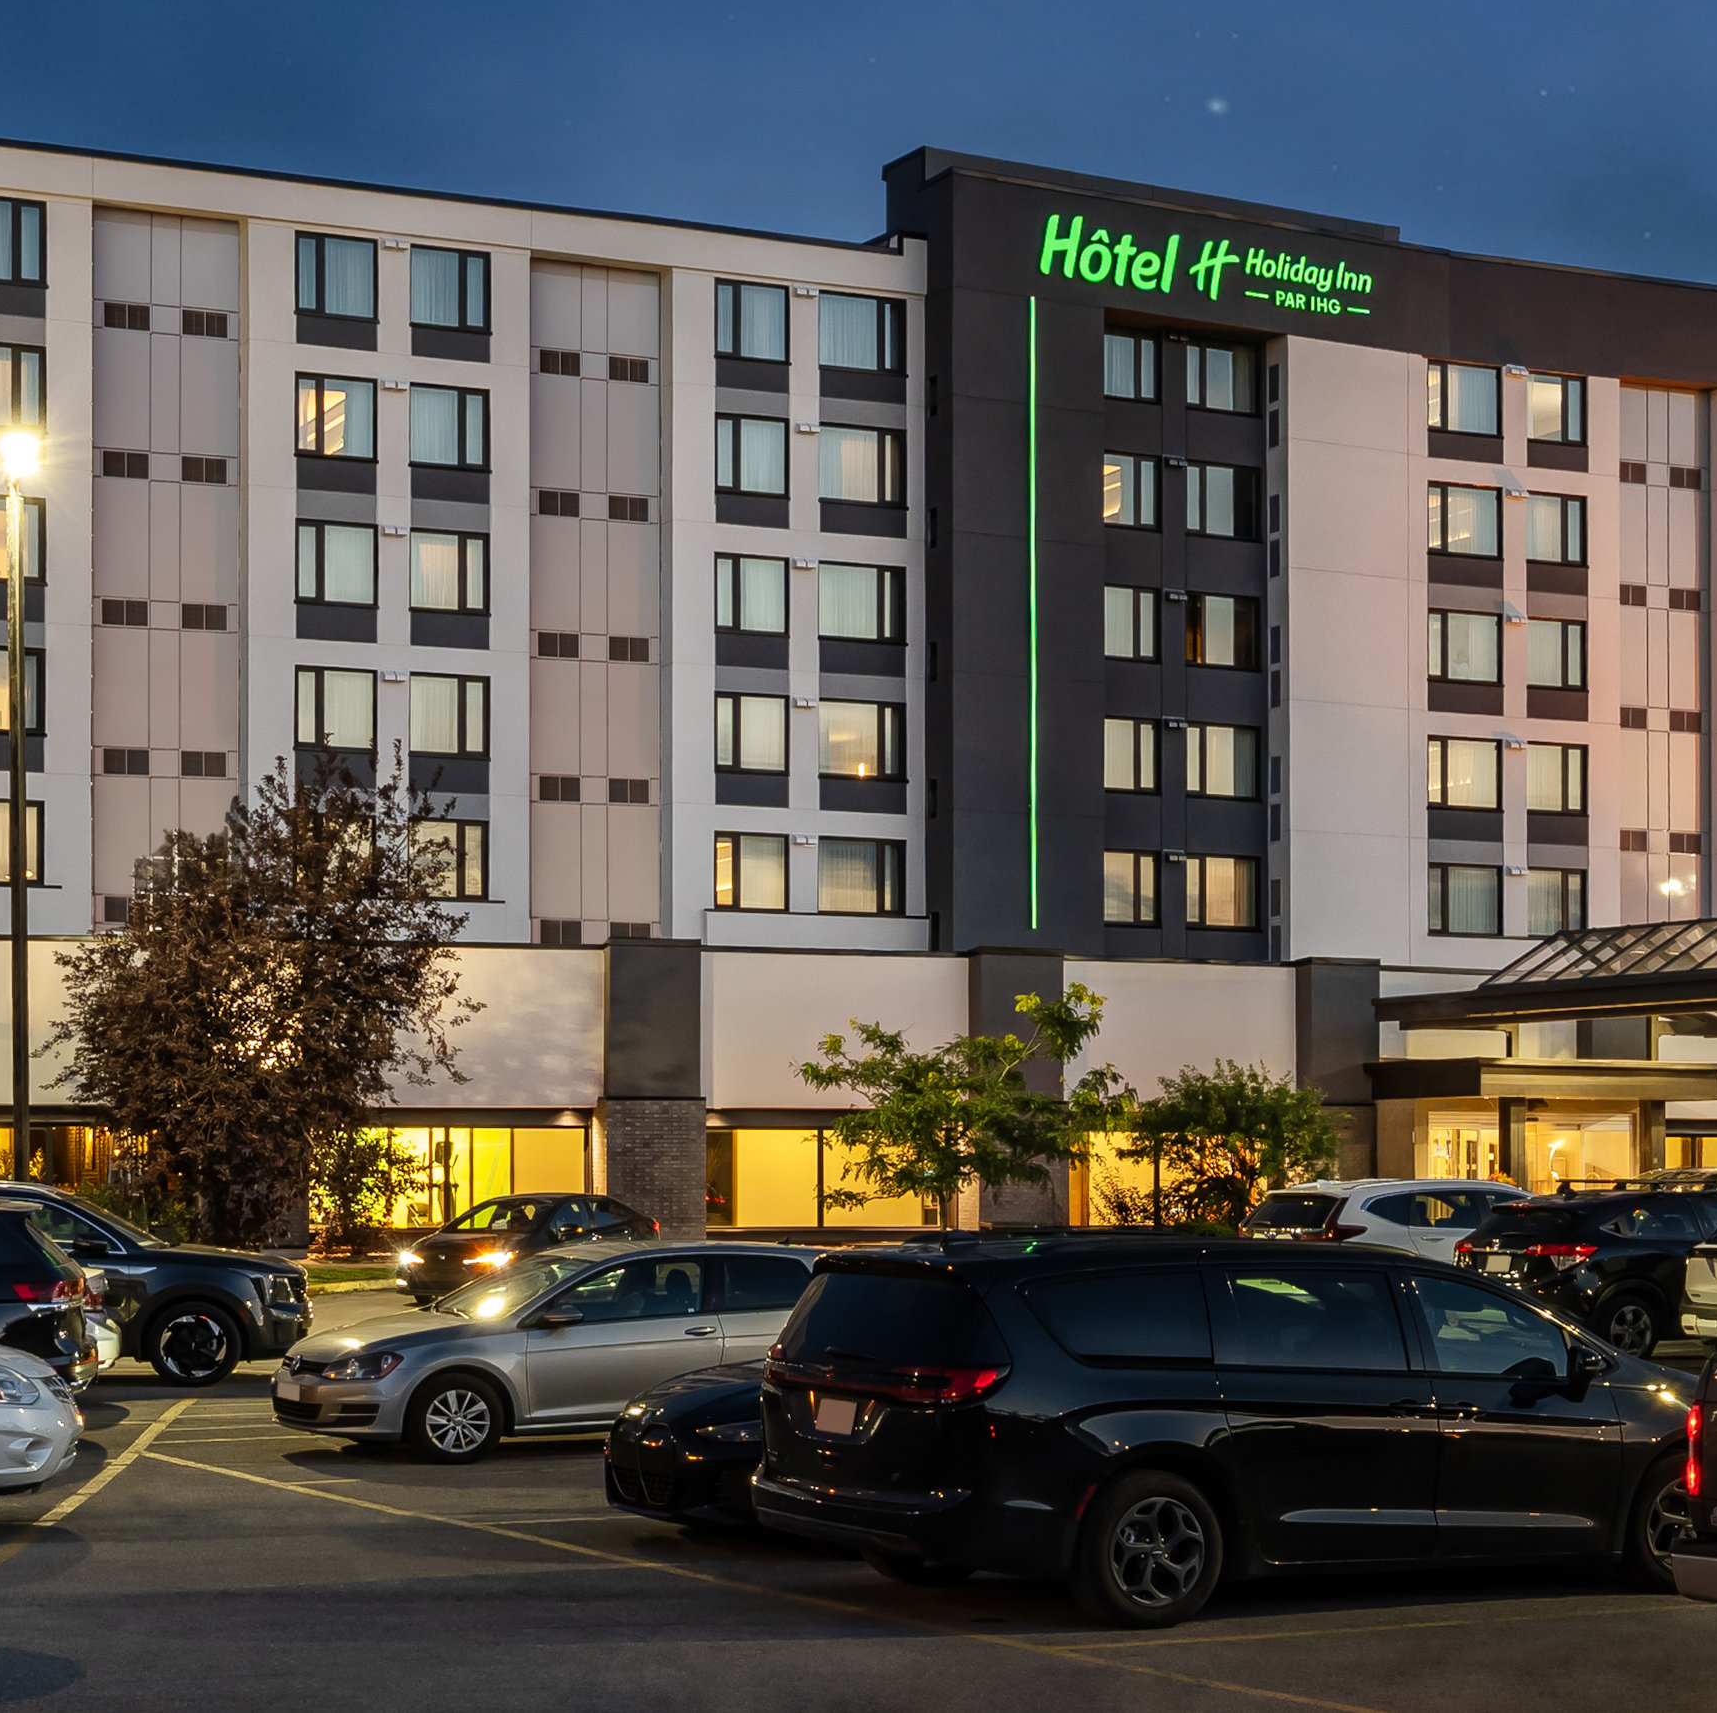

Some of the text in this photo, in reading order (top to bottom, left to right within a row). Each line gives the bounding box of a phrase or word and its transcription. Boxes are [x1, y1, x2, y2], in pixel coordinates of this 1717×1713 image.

[1040, 214, 1180, 294] Hôtel
[1245, 248, 1336, 293] Holiday
[1336, 261, 1373, 294] Inn
[1276, 291, 1342, 315] PAR IHG
